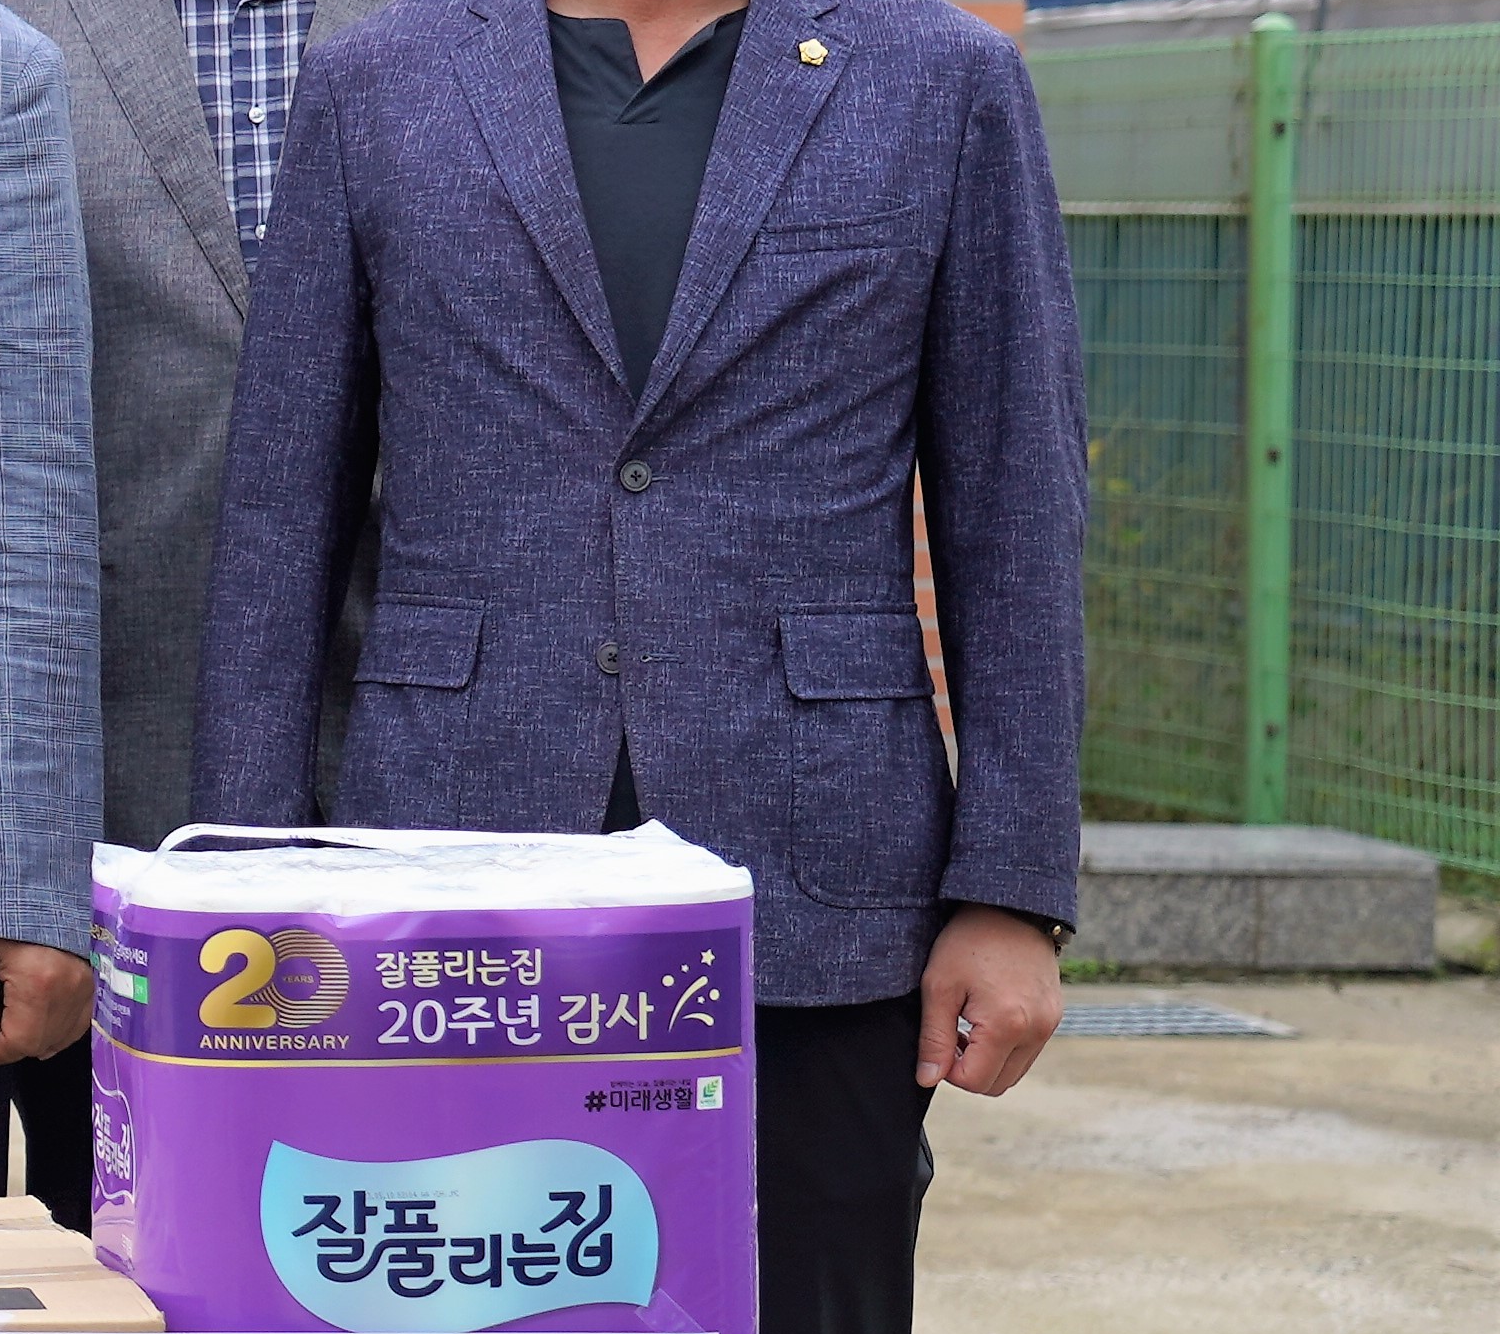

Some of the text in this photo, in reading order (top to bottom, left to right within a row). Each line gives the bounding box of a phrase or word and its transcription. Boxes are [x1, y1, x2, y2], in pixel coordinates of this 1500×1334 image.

[376, 949, 541, 988] 잘풀리는집
[378, 992, 654, 1045] 20주년 감사
[200, 1034, 349, 1050] ANNIVERSARY
[585, 1086, 693, 1112] #미래생활
[291, 1185, 612, 1298] 잘풀리는집
